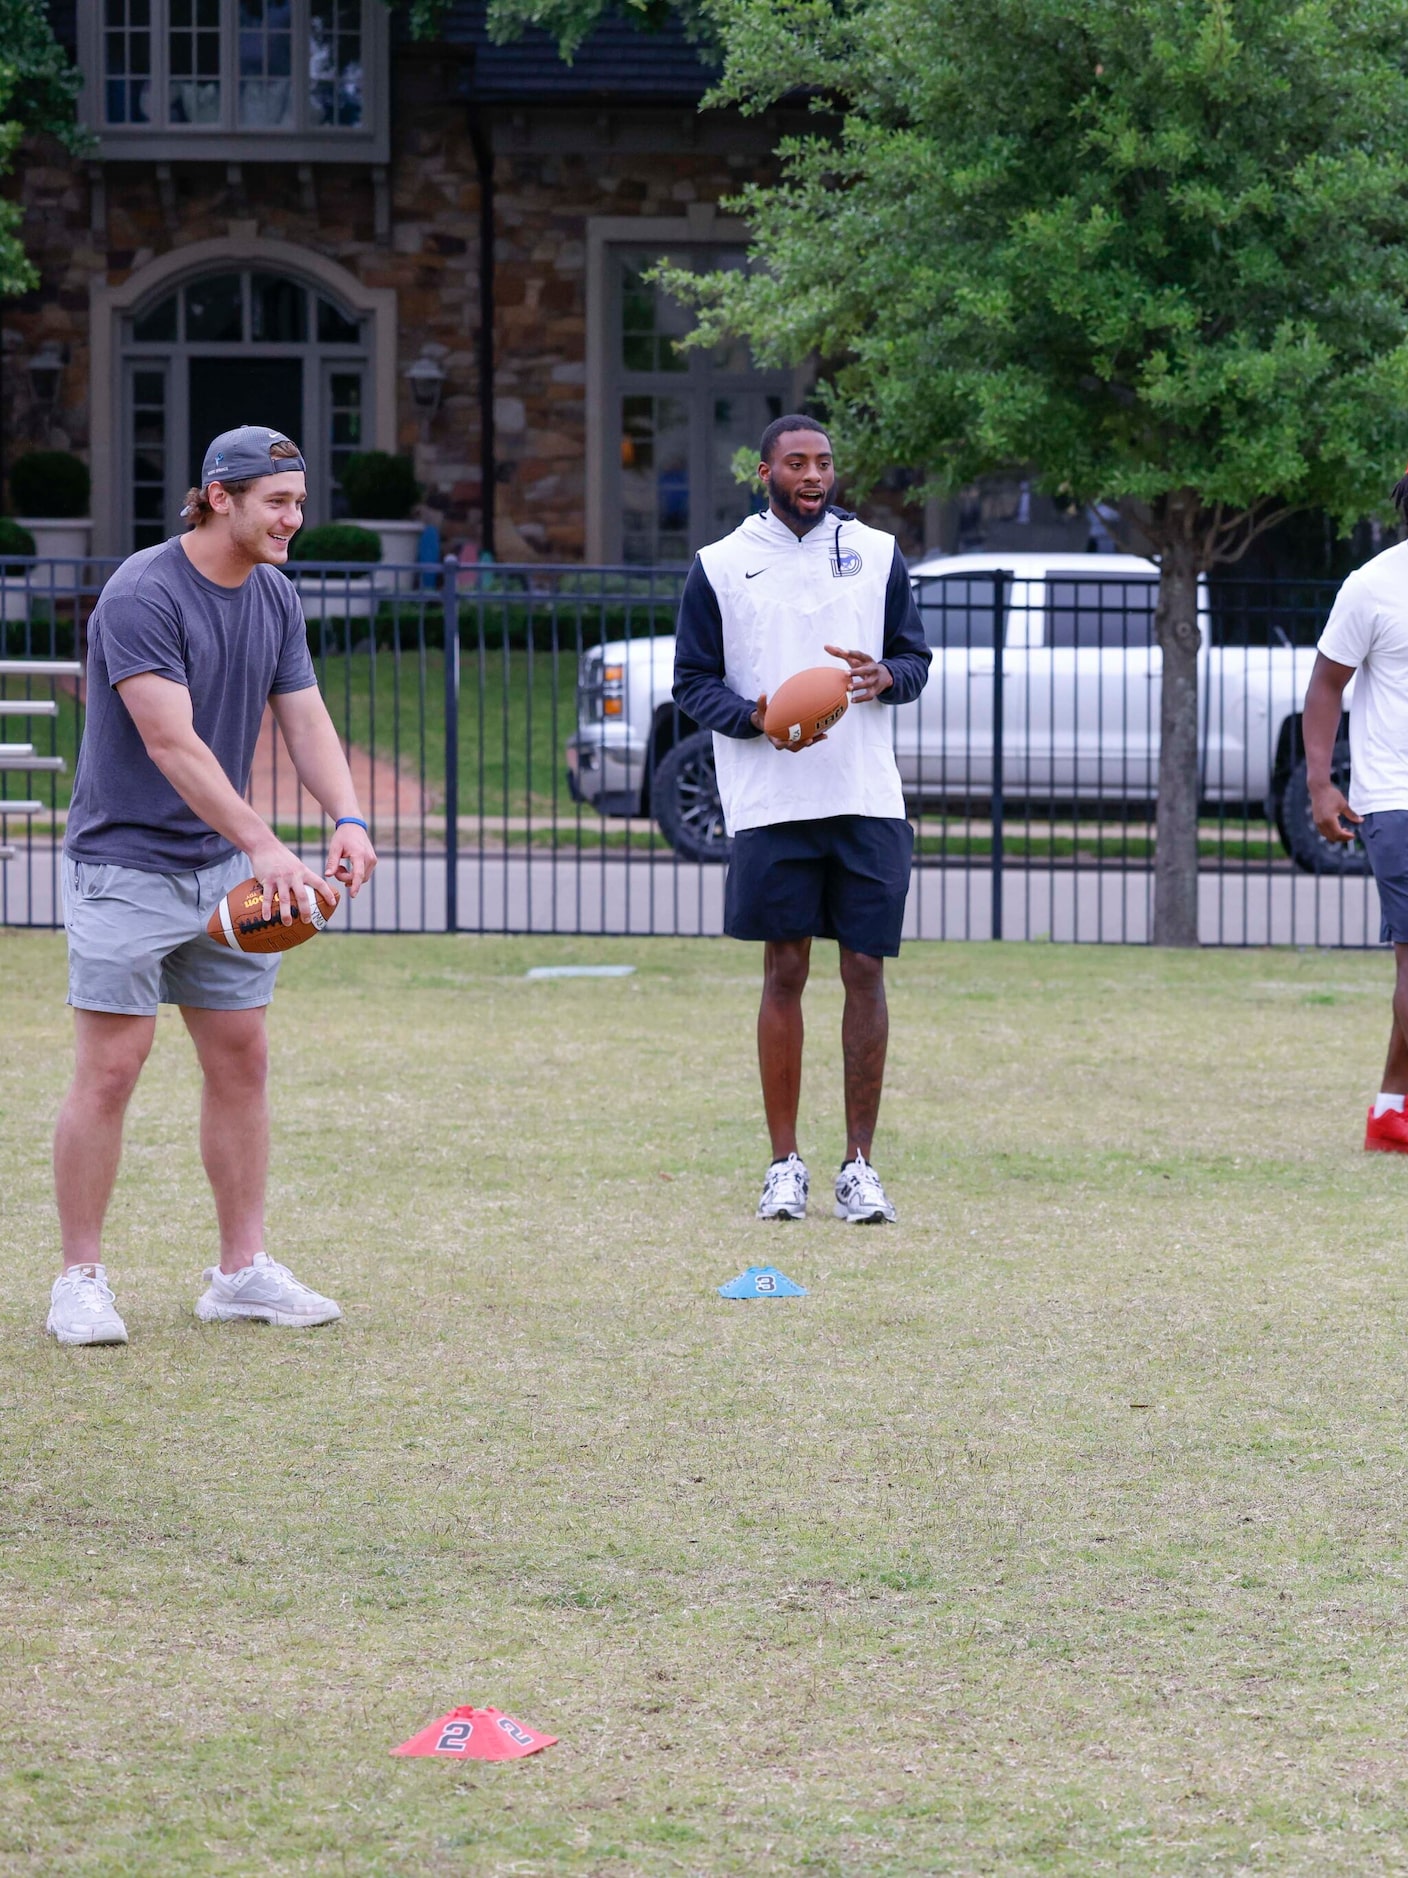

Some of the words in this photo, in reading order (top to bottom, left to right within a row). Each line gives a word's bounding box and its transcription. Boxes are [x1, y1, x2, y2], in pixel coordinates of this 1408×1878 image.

[755, 1275, 776, 1292] 3
[436, 1721, 474, 1751] 2
[497, 1717, 534, 1746] 2
